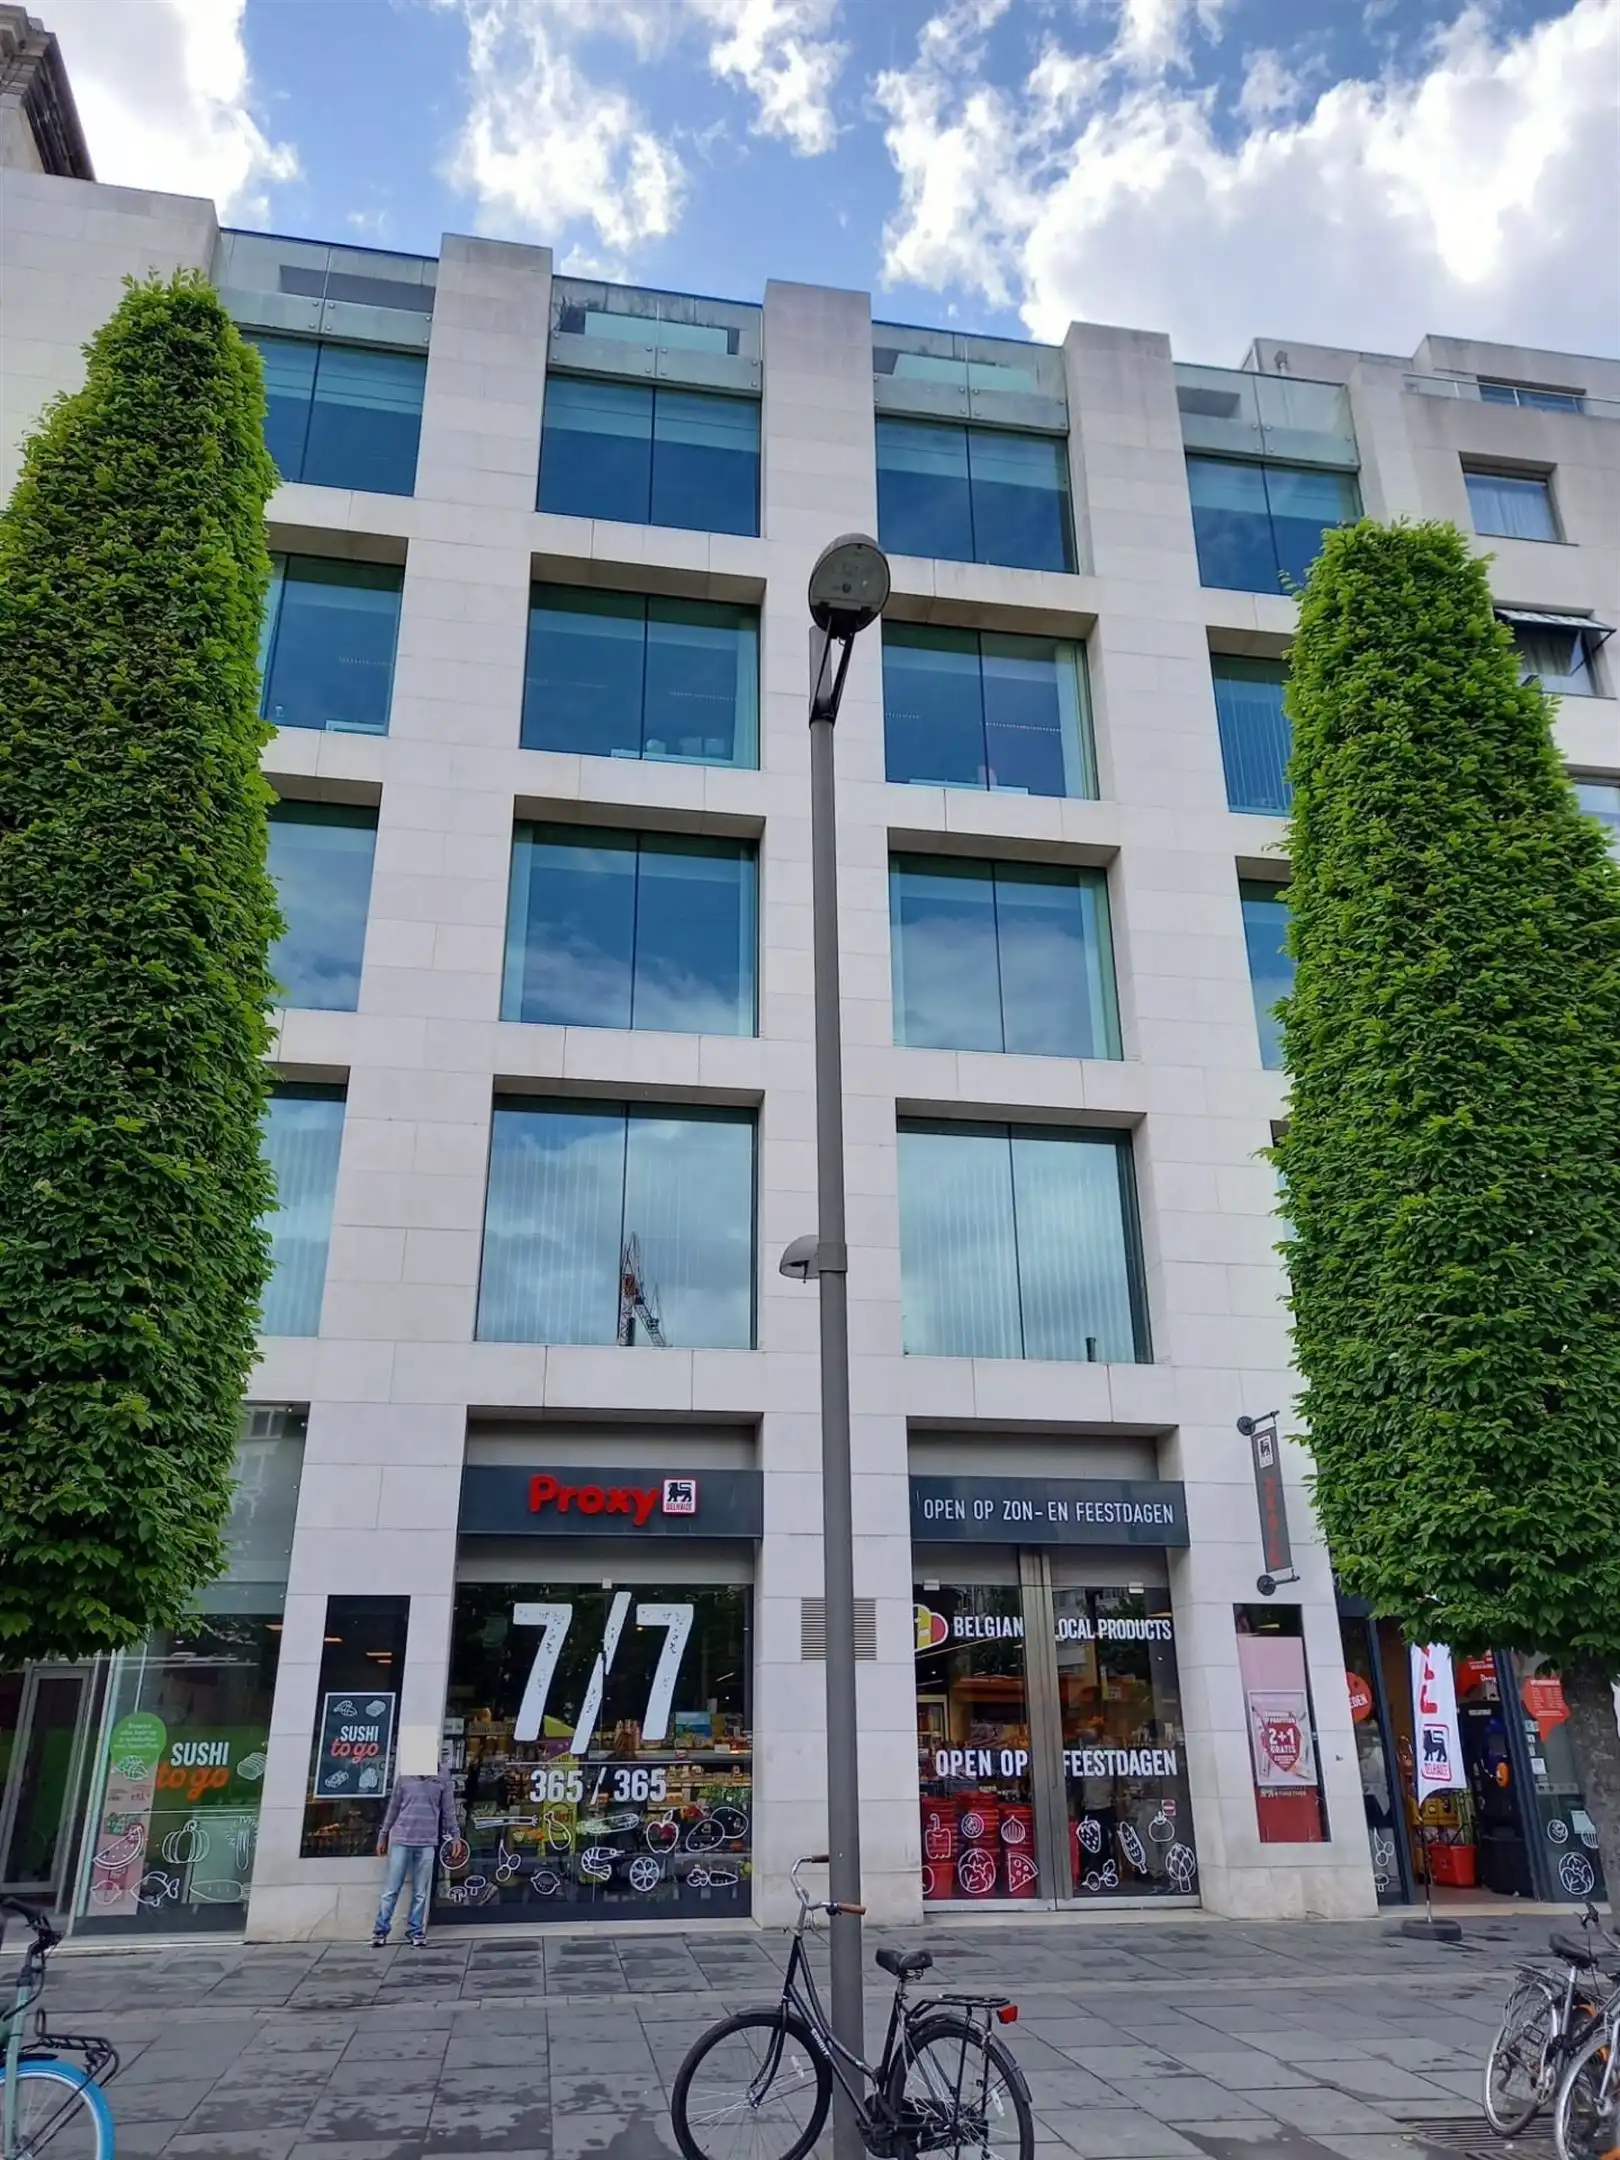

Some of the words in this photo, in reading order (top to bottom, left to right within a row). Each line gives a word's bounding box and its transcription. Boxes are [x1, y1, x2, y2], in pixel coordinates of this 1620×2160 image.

[529, 1474, 659, 1527] Proxy
[924, 1499, 965, 1520] OPEN
[974, 1500, 994, 1521] OP
[1049, 1502, 1068, 1522] EN
[1076, 1502, 1174, 1523] FEESTDAGEN
[954, 1616, 1024, 1637] BELGIAN
[1097, 1619, 1172, 1640] PRODUCTS
[341, 1725, 380, 1742] SUSHI
[1268, 1727, 1295, 1745] 2+1
[170, 1741, 230, 1766] SUSHI
[331, 1738, 351, 1757] to
[352, 1743, 379, 1764] go
[936, 1750, 991, 1776] OPEN
[1001, 1751, 1028, 1776] OP
[1063, 1749, 1178, 1777] FEESTDAGEN
[155, 1762, 187, 1790] to
[188, 1766, 230, 1801] go
[530, 1769, 583, 1802] 365
[613, 1769, 667, 1802] 365
